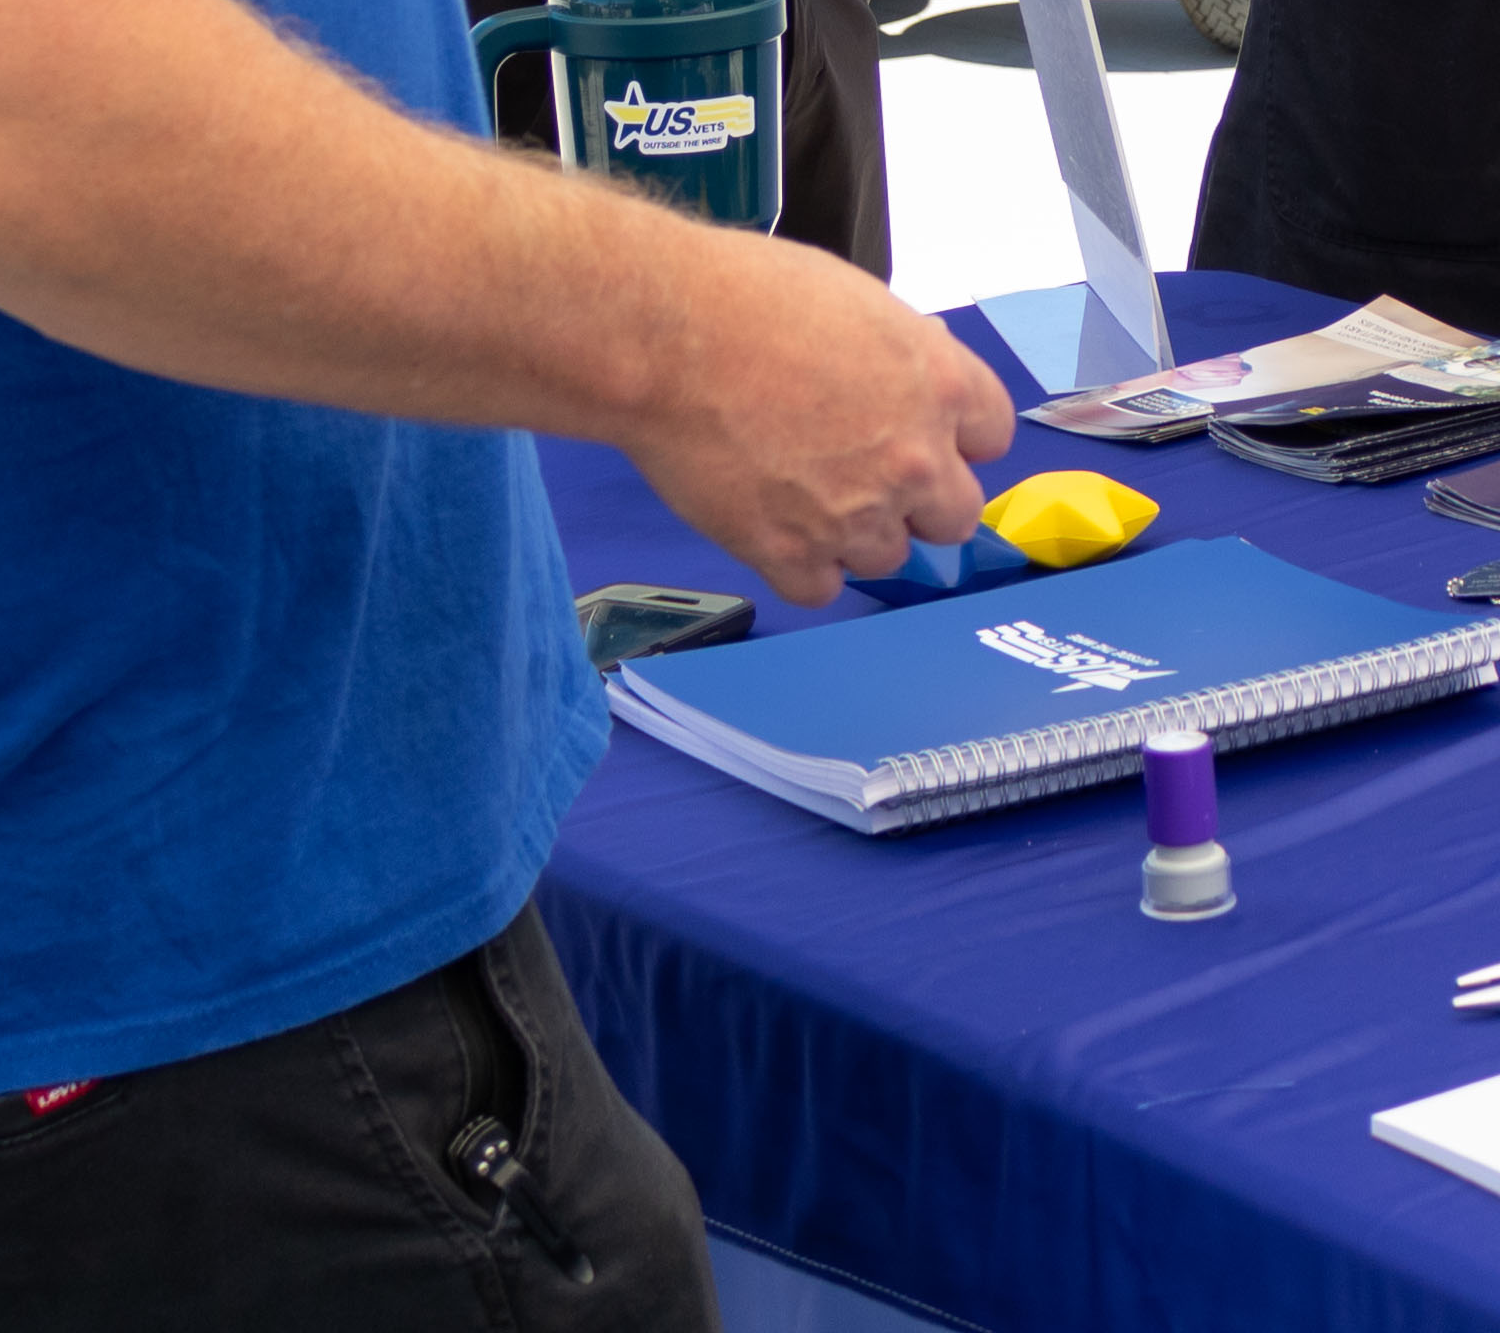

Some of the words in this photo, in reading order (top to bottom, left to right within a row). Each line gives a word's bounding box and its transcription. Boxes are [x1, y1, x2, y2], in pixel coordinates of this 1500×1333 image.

[693, 121, 725, 134] VETS
[643, 140, 681, 150] OUTSIDE
[683, 139, 699, 148] THE
